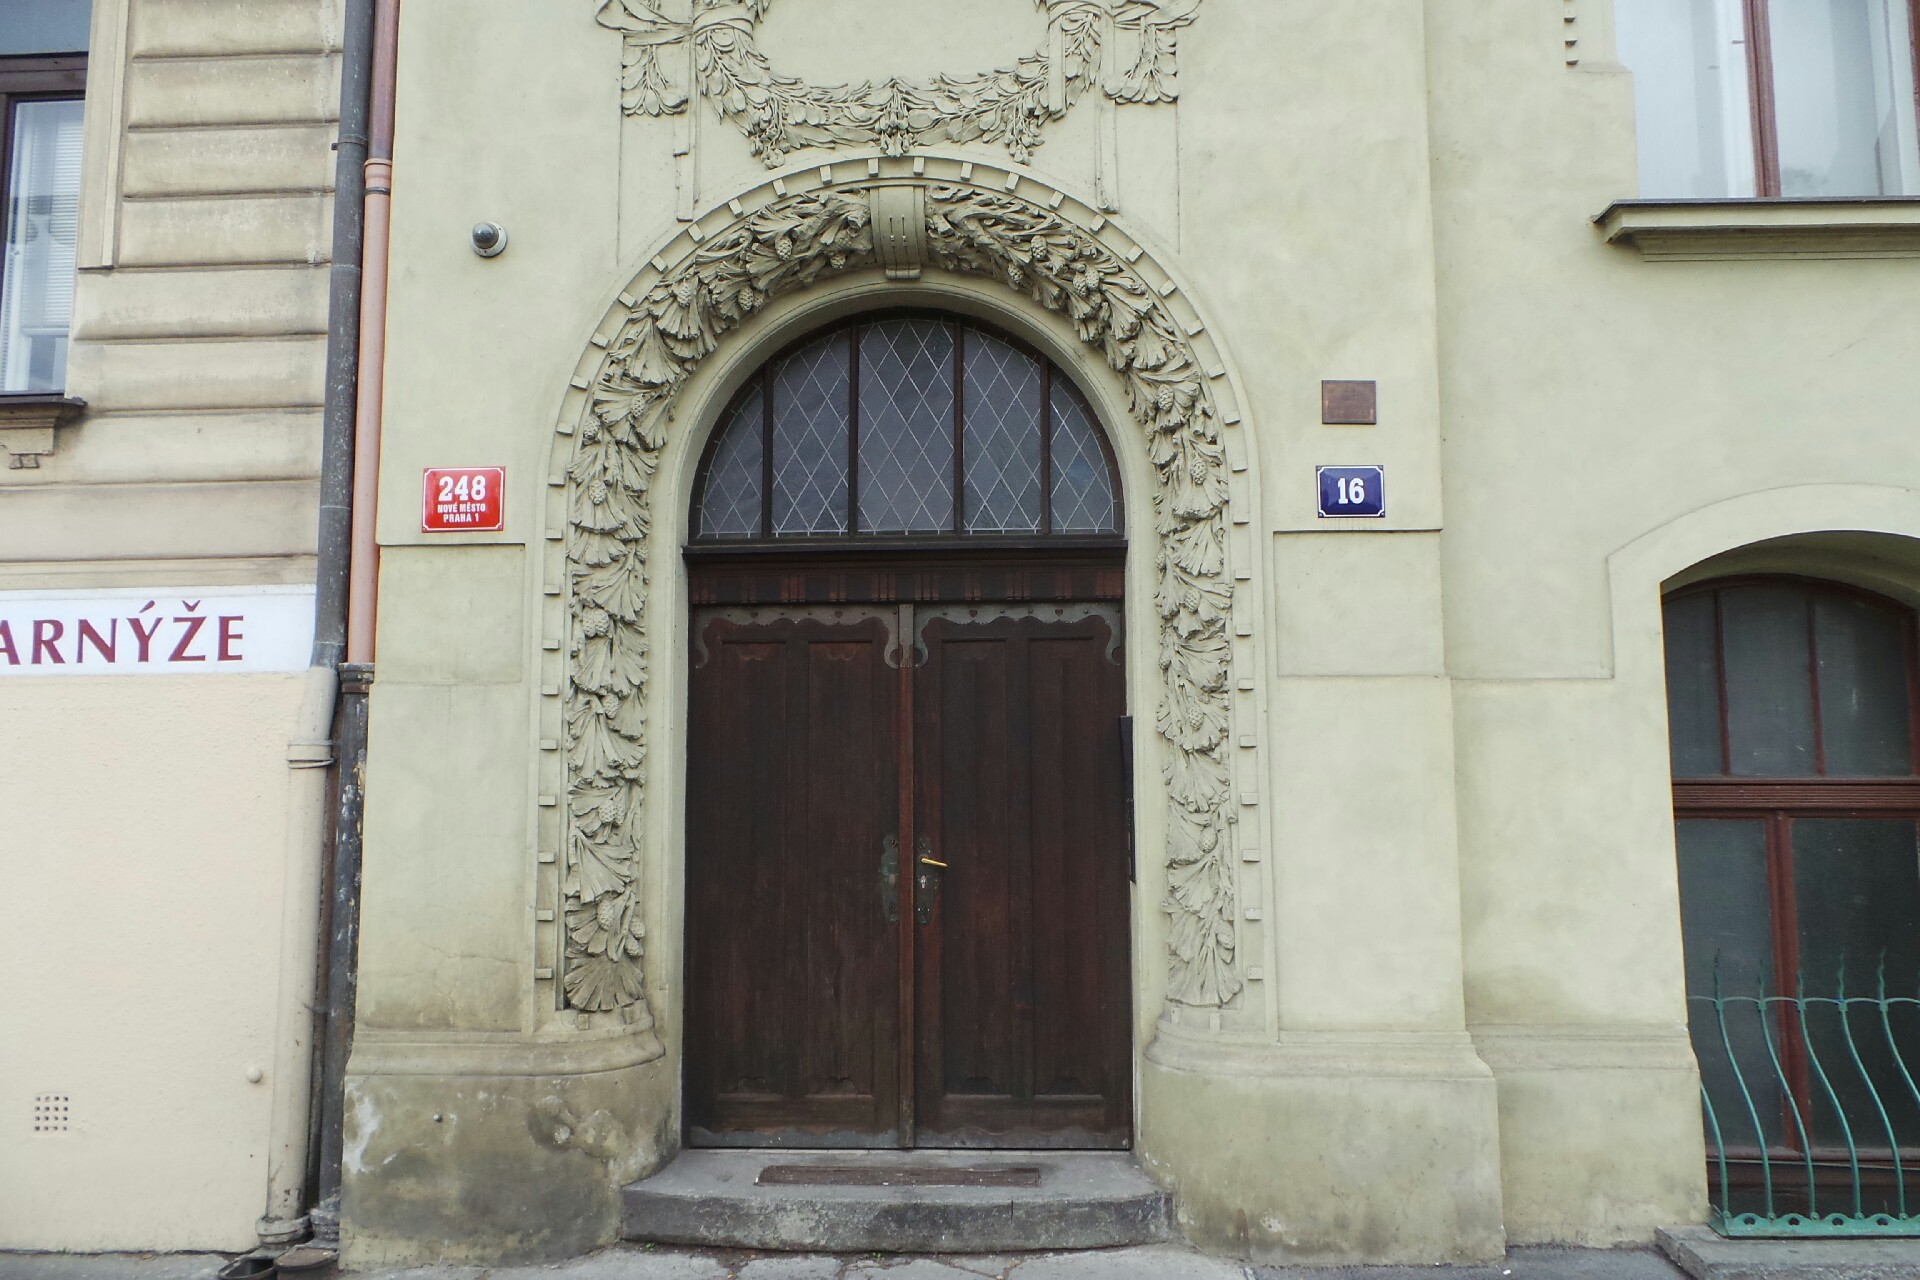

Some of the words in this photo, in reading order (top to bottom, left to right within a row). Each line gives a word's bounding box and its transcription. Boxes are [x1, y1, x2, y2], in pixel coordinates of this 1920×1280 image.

[438, 475, 486, 501] 248
[1337, 477, 1365, 504] 16
[437, 502, 458, 513] NOVÉ
[459, 502, 486, 513] MĚSTO
[443, 513, 472, 523] PRAHA
[474, 513, 479, 522] 1
